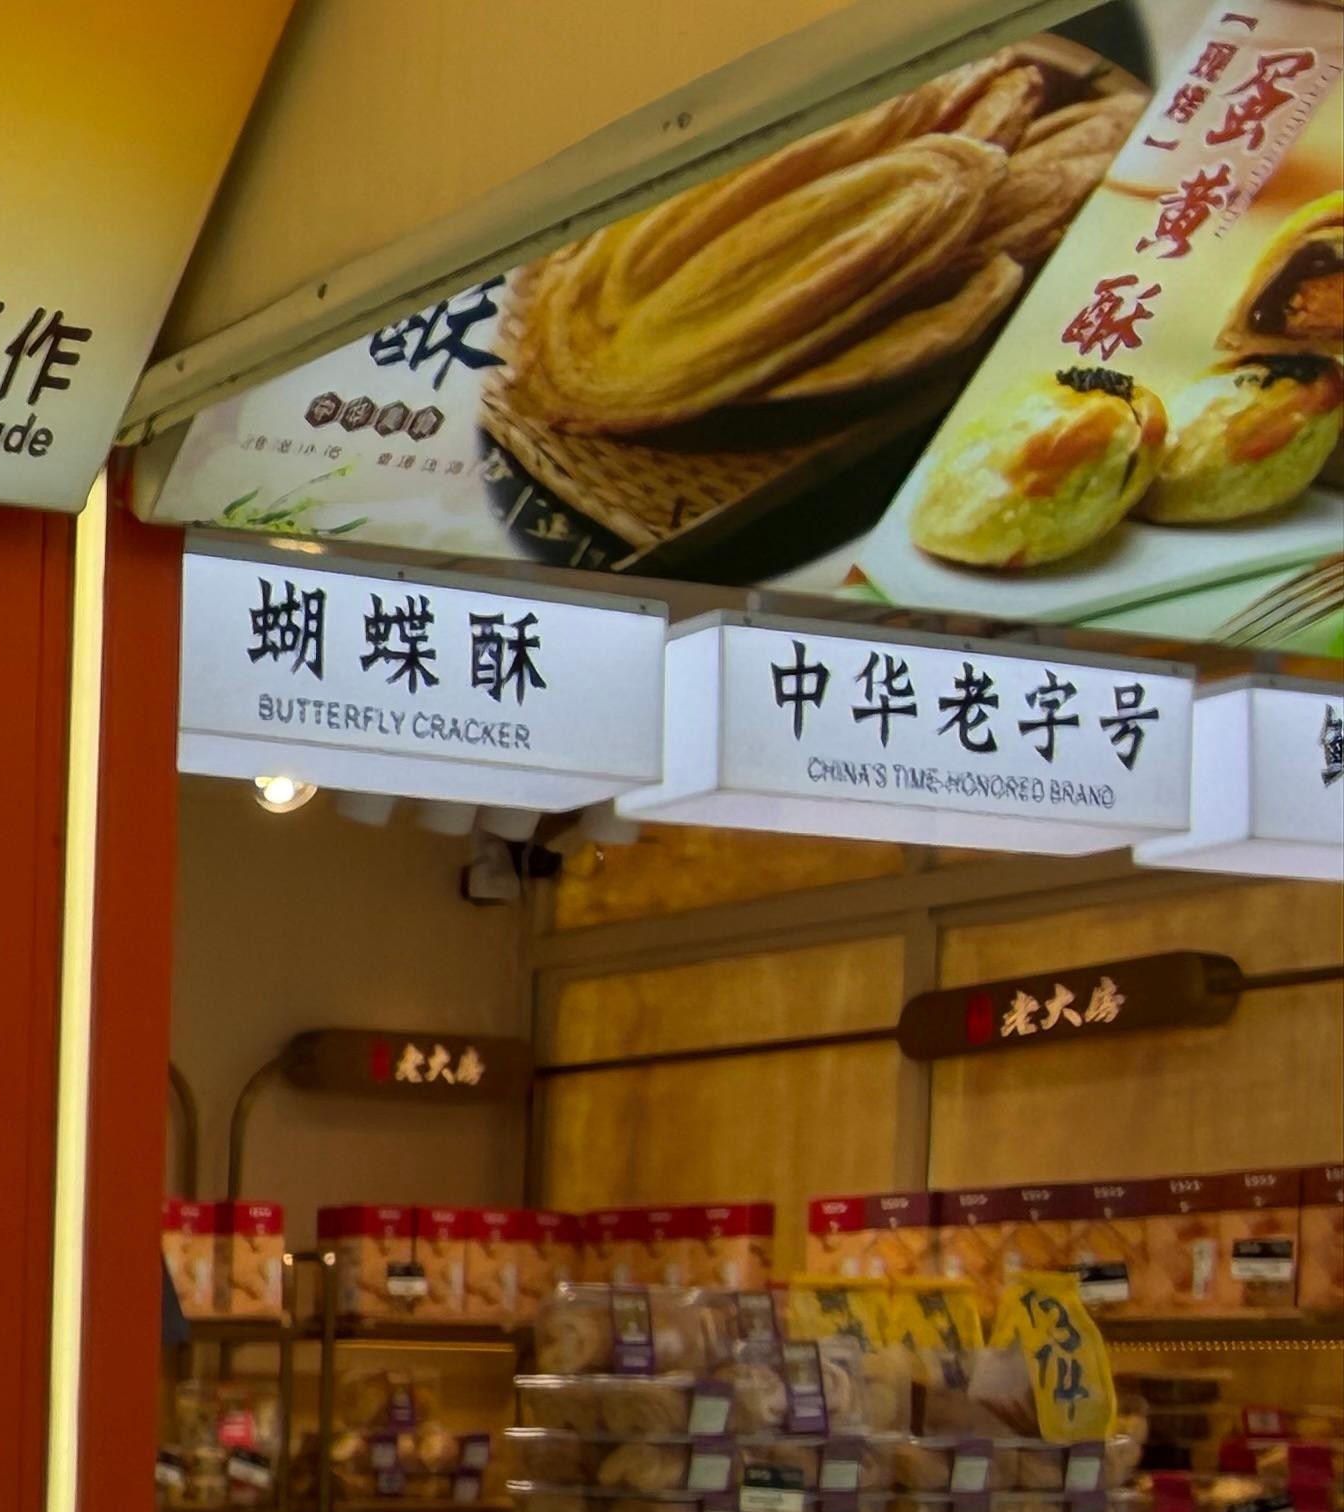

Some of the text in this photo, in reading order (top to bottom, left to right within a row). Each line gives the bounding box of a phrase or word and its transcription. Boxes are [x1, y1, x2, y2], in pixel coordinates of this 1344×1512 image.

[1062, 50, 1316, 362] 蛋黄酥
[247, 577, 547, 706] 蝴蝶酥
[770, 639, 1160, 772] 中华老字号
[258, 693, 532, 750] BUTTERFLY CRACKER
[807, 756, 888, 789] CHINA'S
[1049, 779, 1116, 809] BRAND
